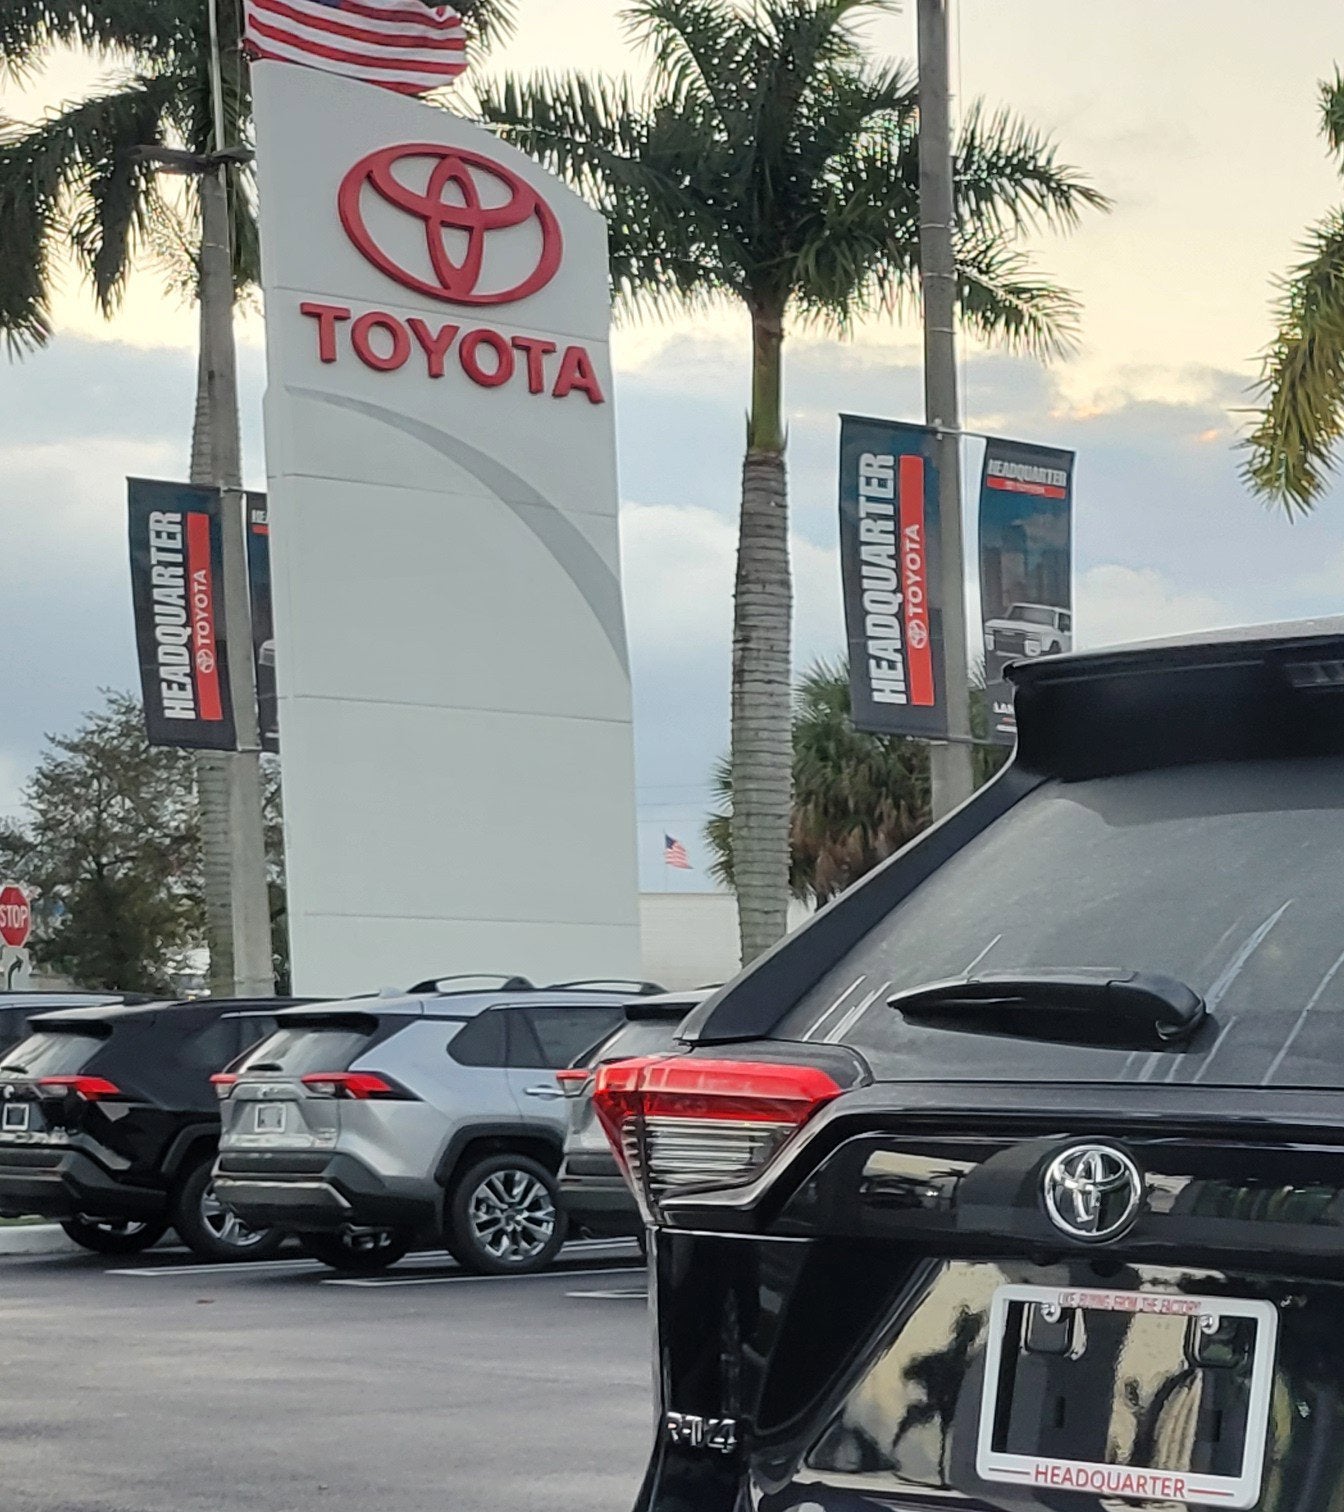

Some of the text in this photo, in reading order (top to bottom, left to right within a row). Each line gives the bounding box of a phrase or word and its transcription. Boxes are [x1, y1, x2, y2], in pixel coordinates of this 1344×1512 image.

[300, 302, 605, 405] TOYOTA
[149, 510, 197, 720] HEADQUARTER
[194, 569, 211, 645] TOYOTA
[859, 452, 907, 705] HEADQUARTER
[904, 524, 923, 617] TOYOTA
[0, 904, 28, 928] STOP
[1034, 1463, 1185, 1498] HEADQUARTER
